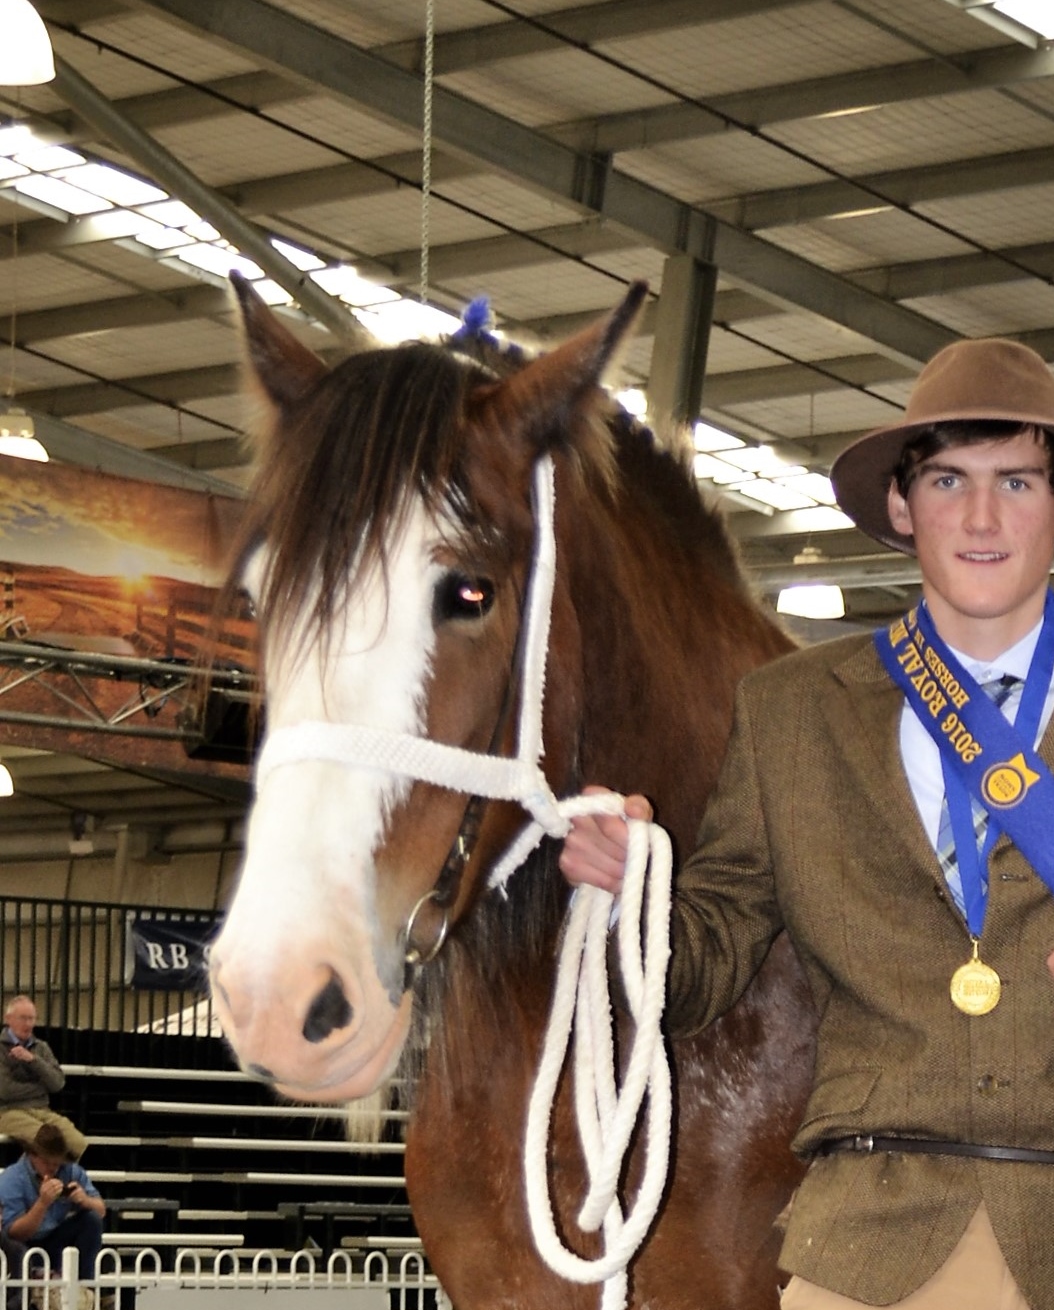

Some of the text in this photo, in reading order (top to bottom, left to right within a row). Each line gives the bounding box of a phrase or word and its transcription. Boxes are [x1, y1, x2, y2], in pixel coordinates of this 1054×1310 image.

[897, 642, 947, 718] ROYAL
[924, 646, 970, 709] HORSES
[941, 713, 983, 764] 2016
